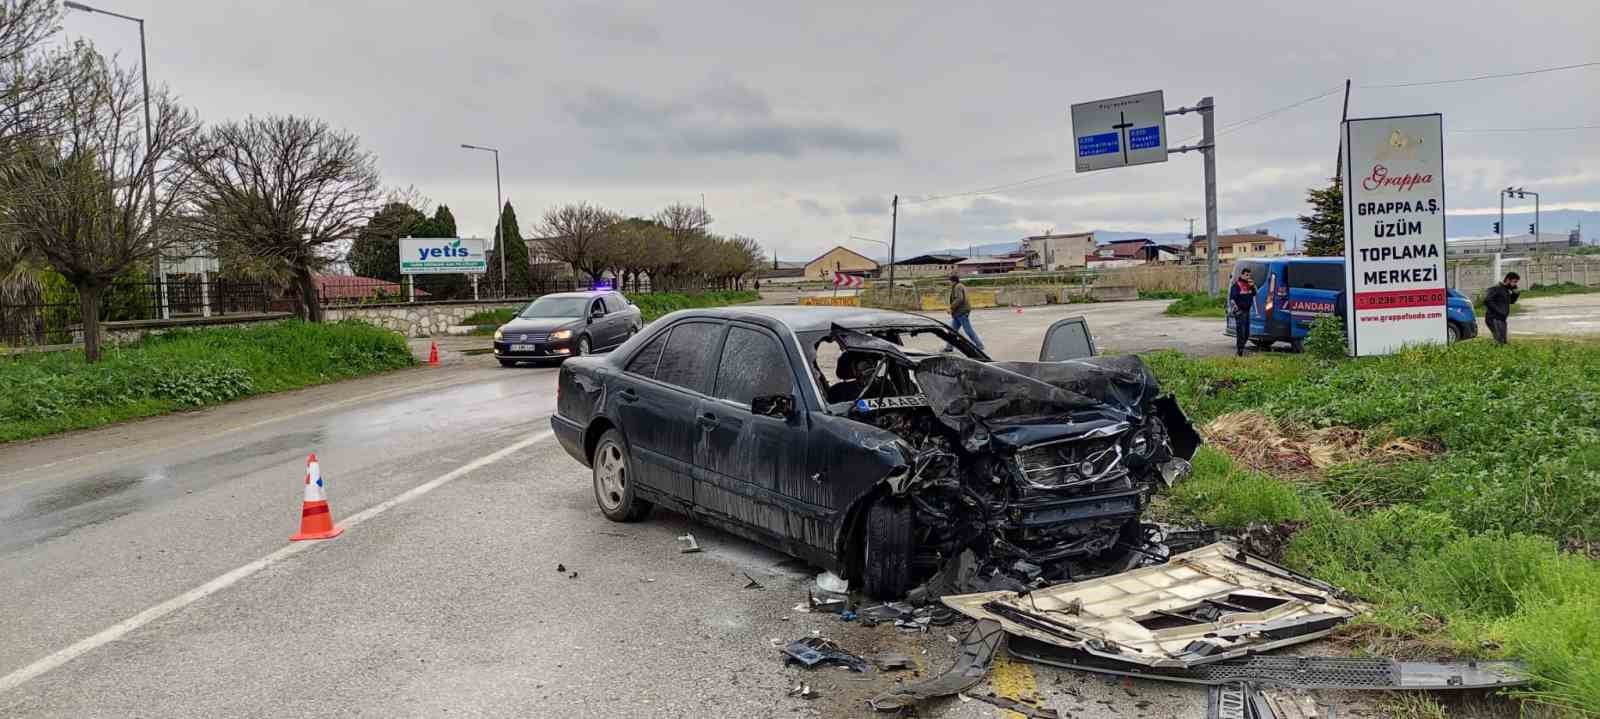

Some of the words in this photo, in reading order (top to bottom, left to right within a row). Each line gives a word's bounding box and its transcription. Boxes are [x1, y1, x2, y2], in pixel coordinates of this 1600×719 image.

[1362, 164, 1433, 192] Grappa
[1358, 201, 1411, 216] GRAPPA
[1415, 198, 1440, 214] A.Ş.
[1374, 218, 1422, 238] ÜZÜM
[1360, 243, 1439, 262] TOPLAMA
[1363, 265, 1437, 285] MERKEZİ
